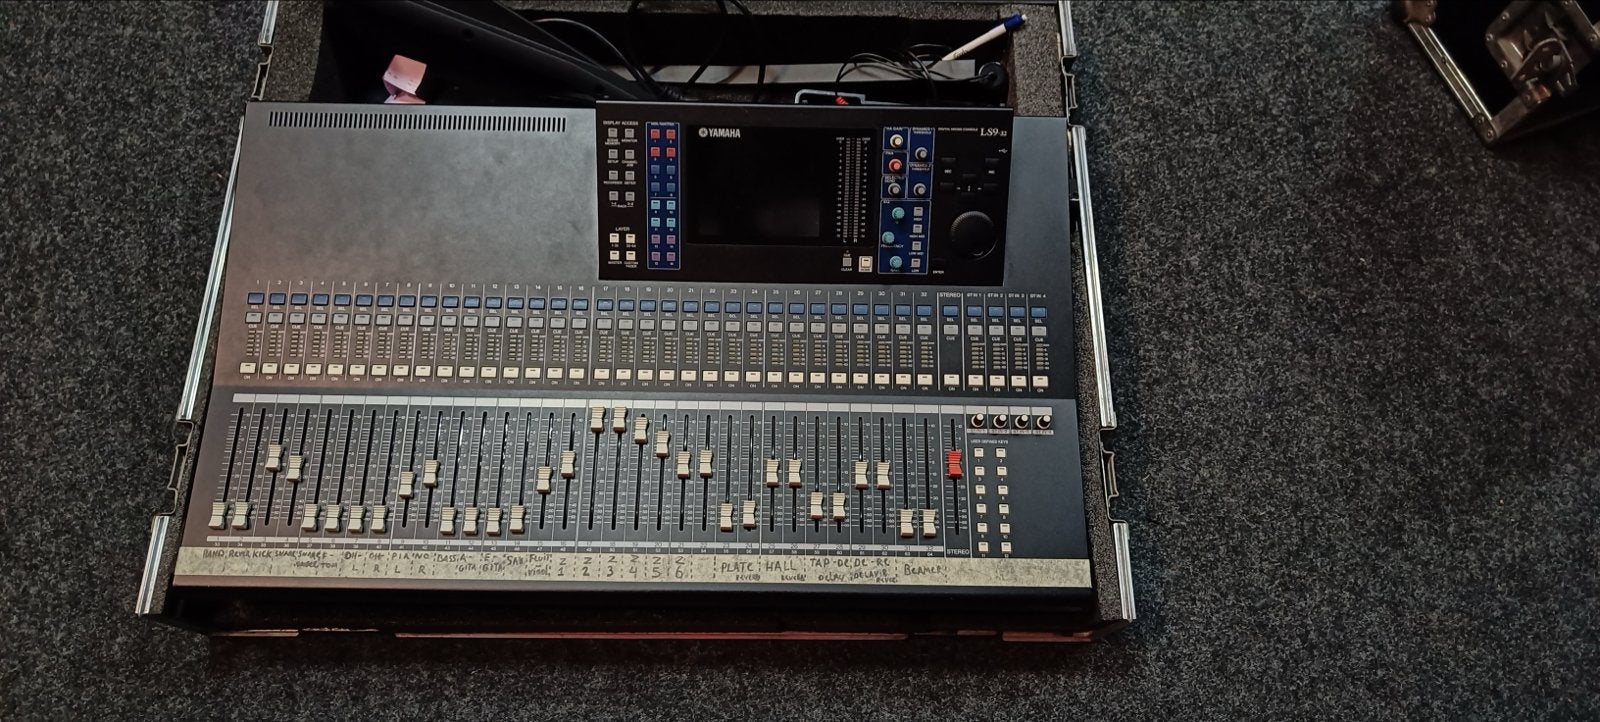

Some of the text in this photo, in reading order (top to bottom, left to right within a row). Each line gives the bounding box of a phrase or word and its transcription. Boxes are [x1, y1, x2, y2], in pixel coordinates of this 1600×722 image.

[708, 128, 740, 138] YAMAHA
[252, 550, 272, 558] KICK
[437, 554, 456, 562] BASS
[766, 560, 797, 572] HALL
[810, 558, 830, 567] TAP
[352, 564, 358, 572] L
[374, 564, 380, 573] R
[395, 564, 400, 574] L
[418, 564, 426, 574] R
[558, 566, 564, 576] 1
[582, 566, 590, 576] 2
[607, 566, 614, 577] 3
[629, 566, 638, 579] 4
[652, 567, 662, 578] 5
[675, 566, 684, 579] 6
